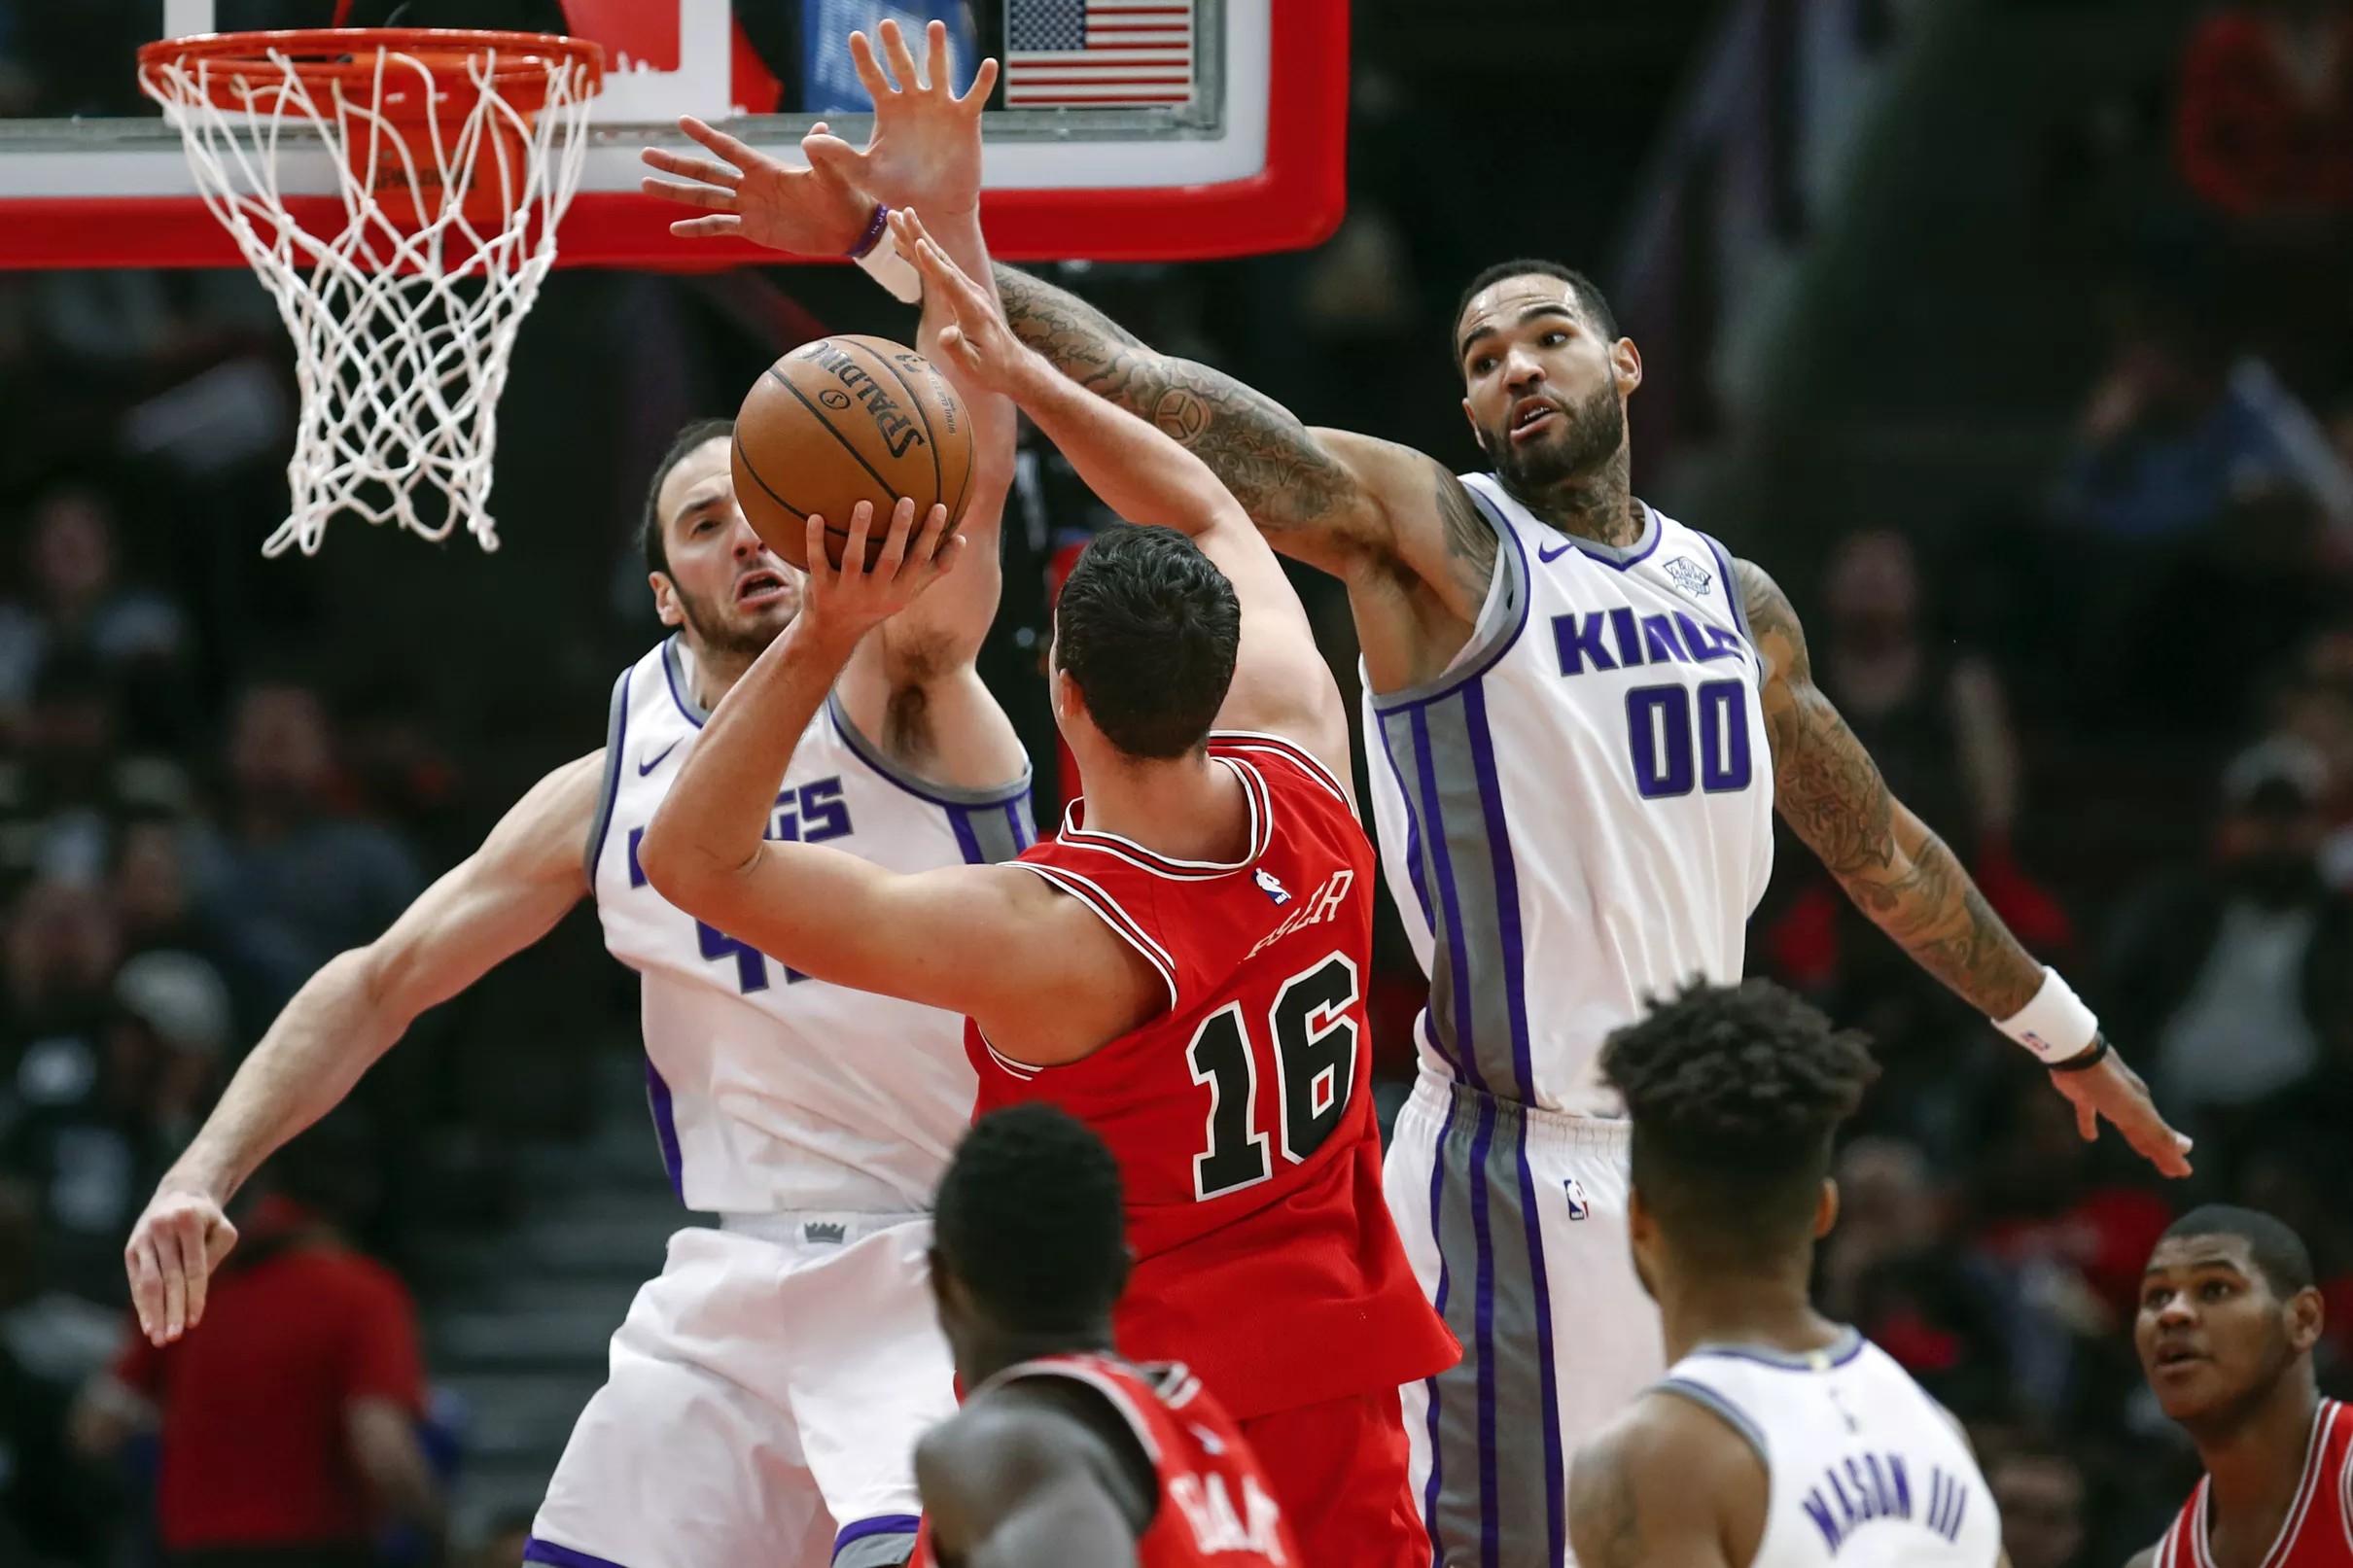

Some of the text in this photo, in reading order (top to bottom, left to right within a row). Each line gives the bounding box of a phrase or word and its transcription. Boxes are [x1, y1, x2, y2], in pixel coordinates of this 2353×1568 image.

[1625, 678, 1752, 800] 00
[1185, 949, 1359, 1202] 16
[1803, 1451, 1969, 1558] MASON III
